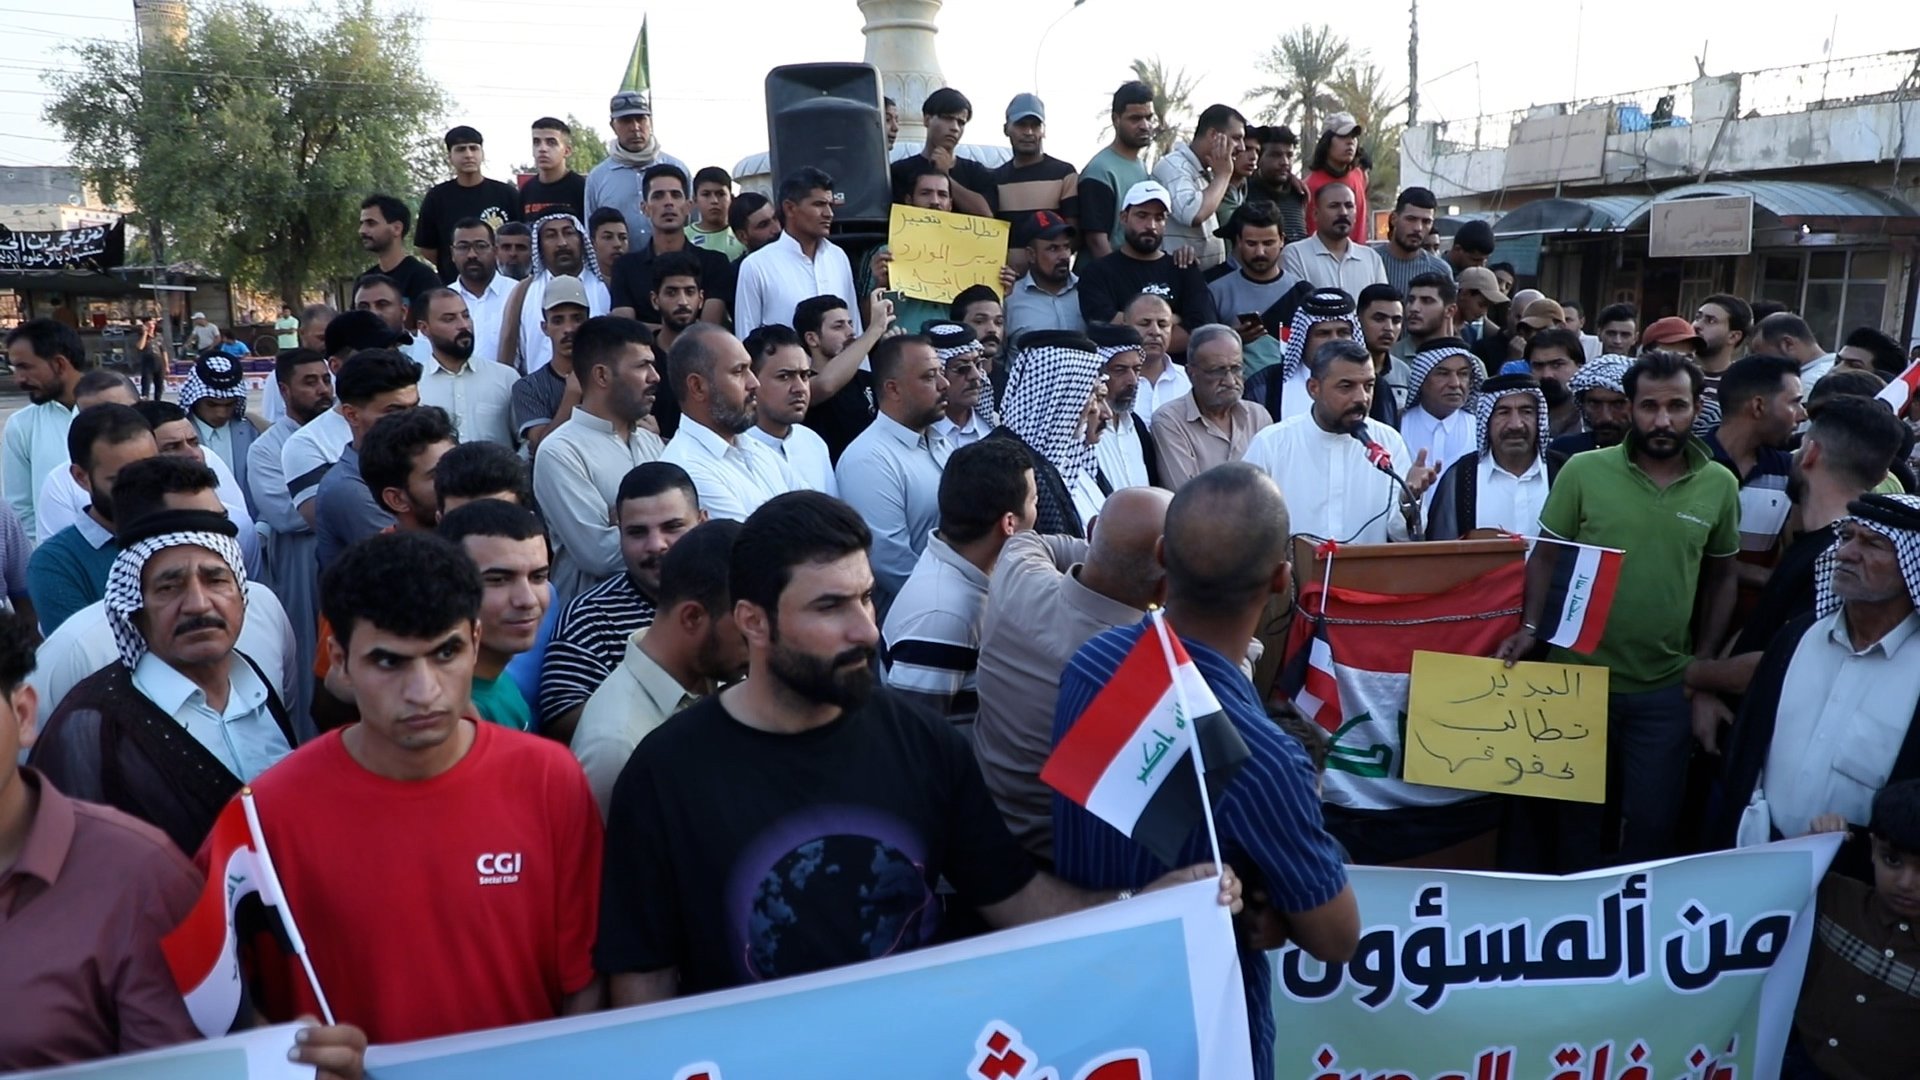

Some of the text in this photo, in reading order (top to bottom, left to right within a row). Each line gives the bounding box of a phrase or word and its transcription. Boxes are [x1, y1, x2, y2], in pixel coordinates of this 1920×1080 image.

[1448, 668, 1581, 704] البدير
[1428, 708, 1590, 743] تطالب
[476, 852, 522, 875] CGI
[1665, 903, 1793, 991] من
